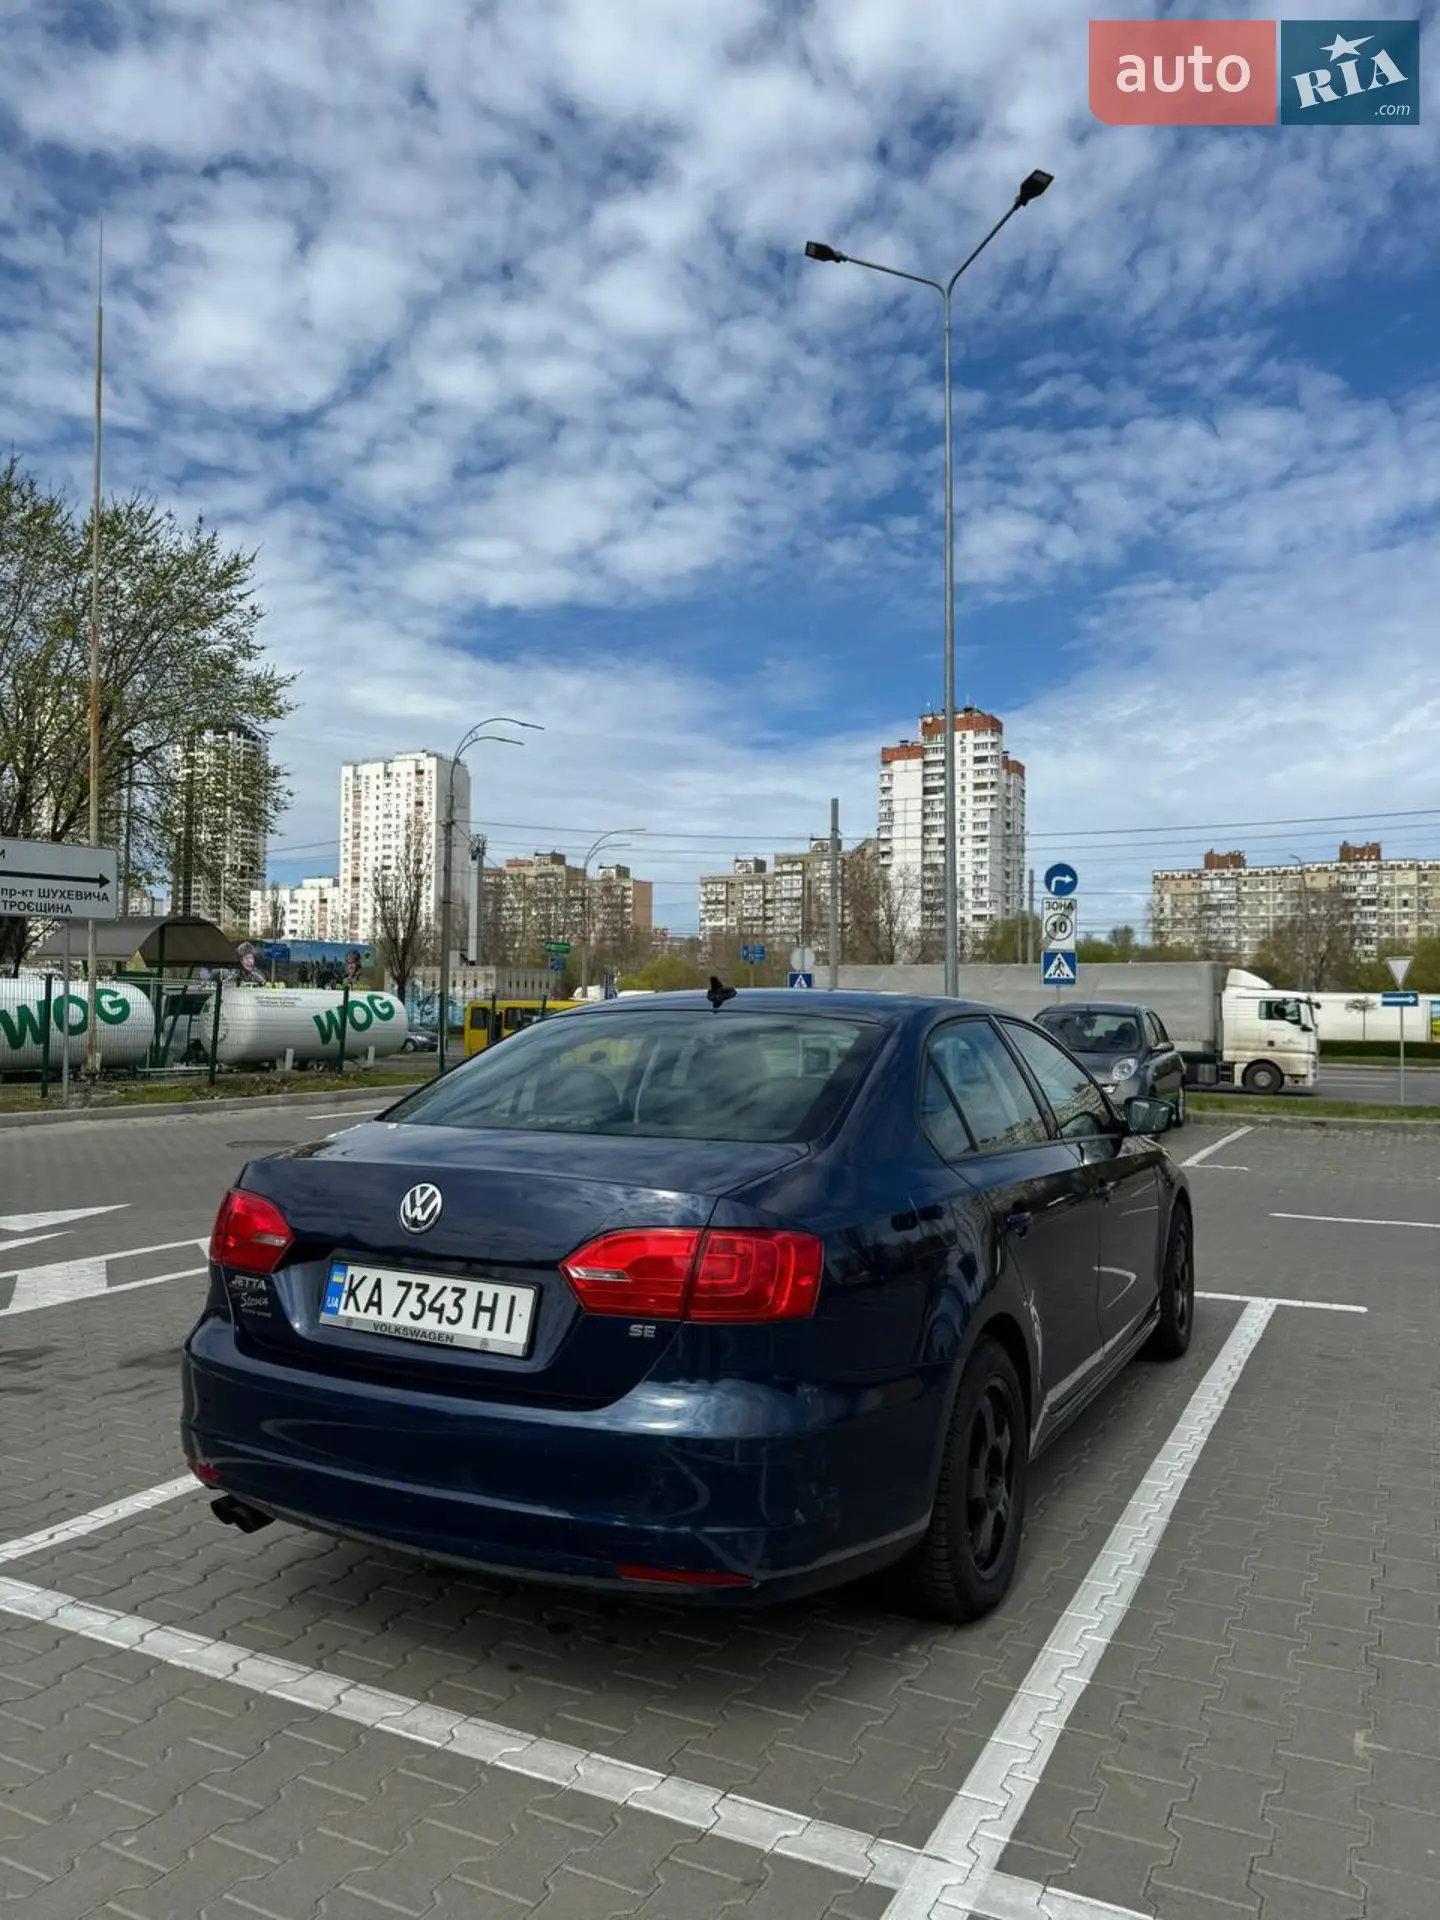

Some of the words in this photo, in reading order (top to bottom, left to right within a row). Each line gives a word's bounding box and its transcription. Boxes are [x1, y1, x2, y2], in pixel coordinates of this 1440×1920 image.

[1, 887, 33, 898] пр-кт
[38, 887, 110, 903] ШУХЕВИЧА
[2, 900, 73, 914] ТРОЄЩИНА
[1045, 900, 1074, 911] ЗОНА
[1050, 920, 1067, 934] 10
[0, 987, 131, 1050] WOG
[313, 993, 396, 1046] WOG
[231, 1275, 266, 1291] JETTA
[326, 1296, 339, 1308] UA
[343, 1273, 383, 1316] KA
[391, 1280, 467, 1326] 7343
[471, 1290, 517, 1335] HI
[372, 1322, 455, 1343] VOLKSWAGEN
[629, 1324, 656, 1338] SE
